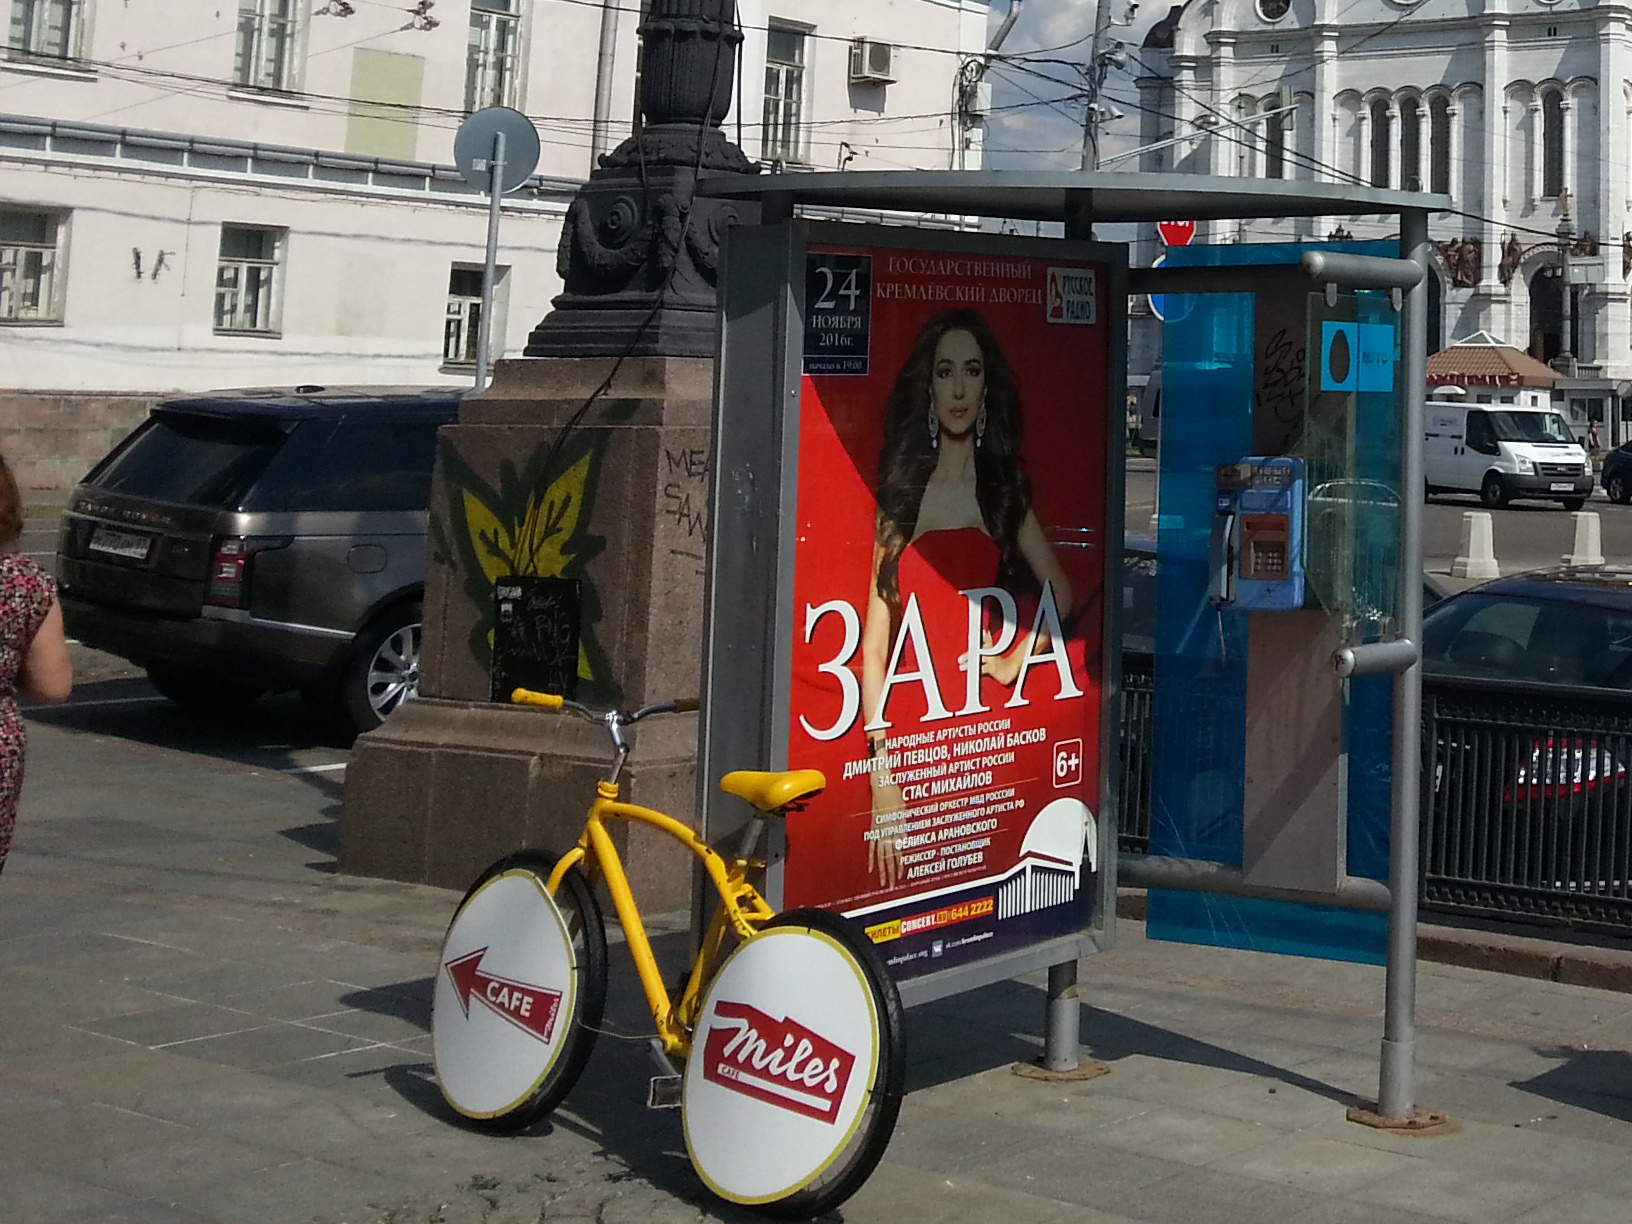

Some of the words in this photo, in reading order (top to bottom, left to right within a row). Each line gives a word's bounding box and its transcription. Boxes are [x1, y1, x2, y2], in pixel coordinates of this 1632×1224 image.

[888, 256, 1032, 279] ГОСУДАРСТВЕННЫЙ
[814, 266, 860, 311] 24
[876, 281, 985, 302] КРЕМЛЁВСКИЙ
[988, 287, 1043, 304] ДВОРЕЦ
[811, 315, 861, 329] НОЯБРЯ
[1066, 299, 1091, 320] РАДИО
[819, 333, 854, 347] 2016г.
[799, 578, 1084, 741] ЗАРА
[885, 730, 934, 750] НАРОДНЫЕ
[936, 724, 976, 742] АРТИСТЫ
[977, 718, 1011, 734] РОССИИ
[843, 751, 901, 780] ДМИТРИЙ
[903, 744, 951, 766] ПЕВЦОВ,
[953, 733, 1004, 758] НИКОЛАЙ
[1006, 728, 1047, 747] БАСКОВ
[1056, 751, 1080, 777] 6+
[878, 762, 947, 788] ЗАСЛУЖЕННЫЙ
[948, 757, 980, 775] АРТИСТ
[981, 752, 1015, 768] РОССИИ
[902, 782, 930, 801] СТАС
[931, 771, 993, 796] МИХАЙЛОВ
[863, 829, 880, 842] ПОД
[881, 818, 932, 838] УПРАВЛЕНИЕМ
[931, 808, 985, 827] ЗАСЛУЖЕННОГО
[985, 801, 1014, 815] АРТИСТА
[1014, 798, 1025, 809] РФ
[875, 802, 938, 825] СИМФОНИЧЕСКИЙ
[939, 797, 969, 812] ОРКЕСТР
[969, 794, 985, 806] МВД
[985, 788, 1015, 802] РОССИИ
[895, 831, 936, 850] ФЕЛИКСА
[937, 818, 998, 841] АРАНОВСКОГО
[900, 849, 936, 866] РЕЖИССЕР
[940, 837, 991, 856] ПОСТАНОВЩИК
[907, 858, 945, 879] АЛЕКСЕЙ
[947, 852, 984, 870] ГОЛУБЕВ
[951, 905, 969, 920] 644
[970, 898, 994, 916] 2222
[486, 981, 534, 1018] CAFE
[721, 1065, 740, 1079] CAFE
